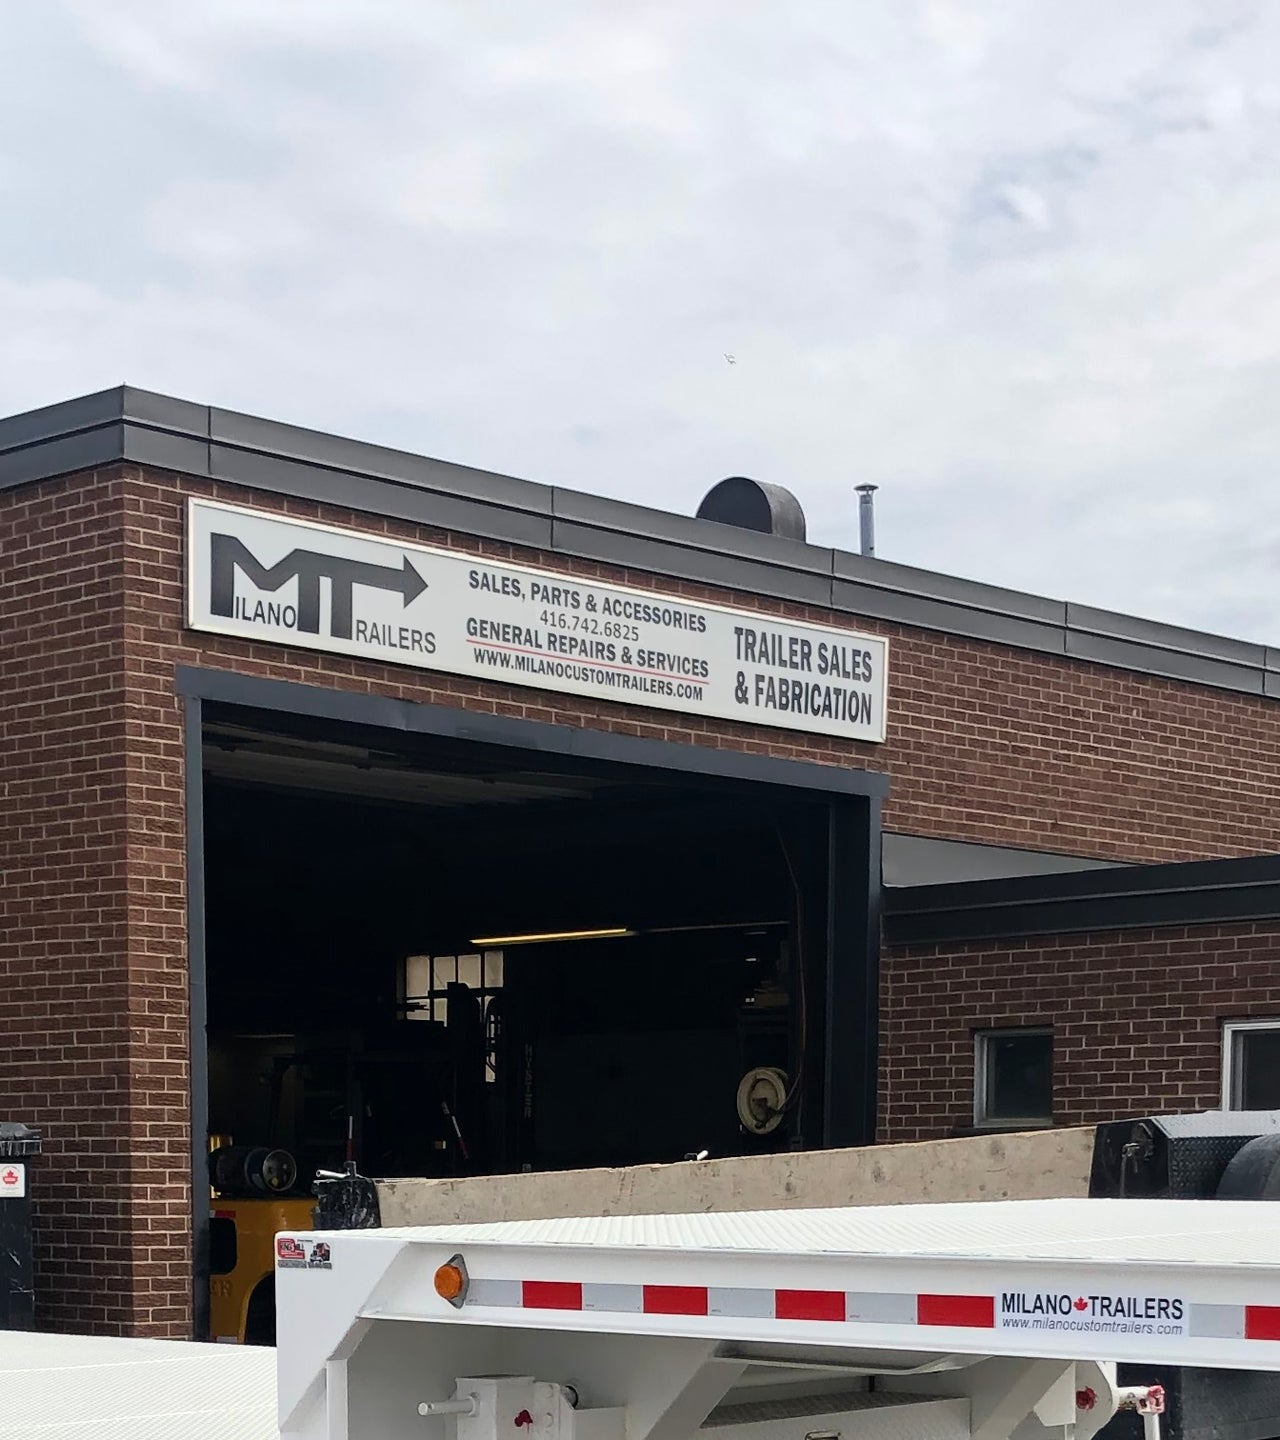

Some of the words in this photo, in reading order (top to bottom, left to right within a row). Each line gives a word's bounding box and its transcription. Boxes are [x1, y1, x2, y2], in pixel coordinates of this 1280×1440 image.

[469, 569, 526, 602] SALES,
[531, 582, 580, 609] PARTS
[585, 593, 597, 613] &
[602, 597, 707, 633] ACCESSORIES
[540, 609, 639, 642] 416.742.6825
[466, 617, 543, 649] GENERAL
[547, 632, 616, 662] REPAIRS
[621, 646, 633, 665] &
[637, 649, 709, 678] SERVICES
[473, 647, 703, 701] WWW.MILANOCUSTOMTRAILERS.COM
[734, 626, 812, 672] TRAILER
[817, 642, 873, 683] SALES
[734, 671, 749, 705] &
[755, 674, 872, 725] FABRICATION
[1002, 1293, 1071, 1315] MILANO
[1088, 1296, 1183, 1320] TRAILERS
[1002, 1317, 1183, 1335] www.milanocustomtrailers.com
